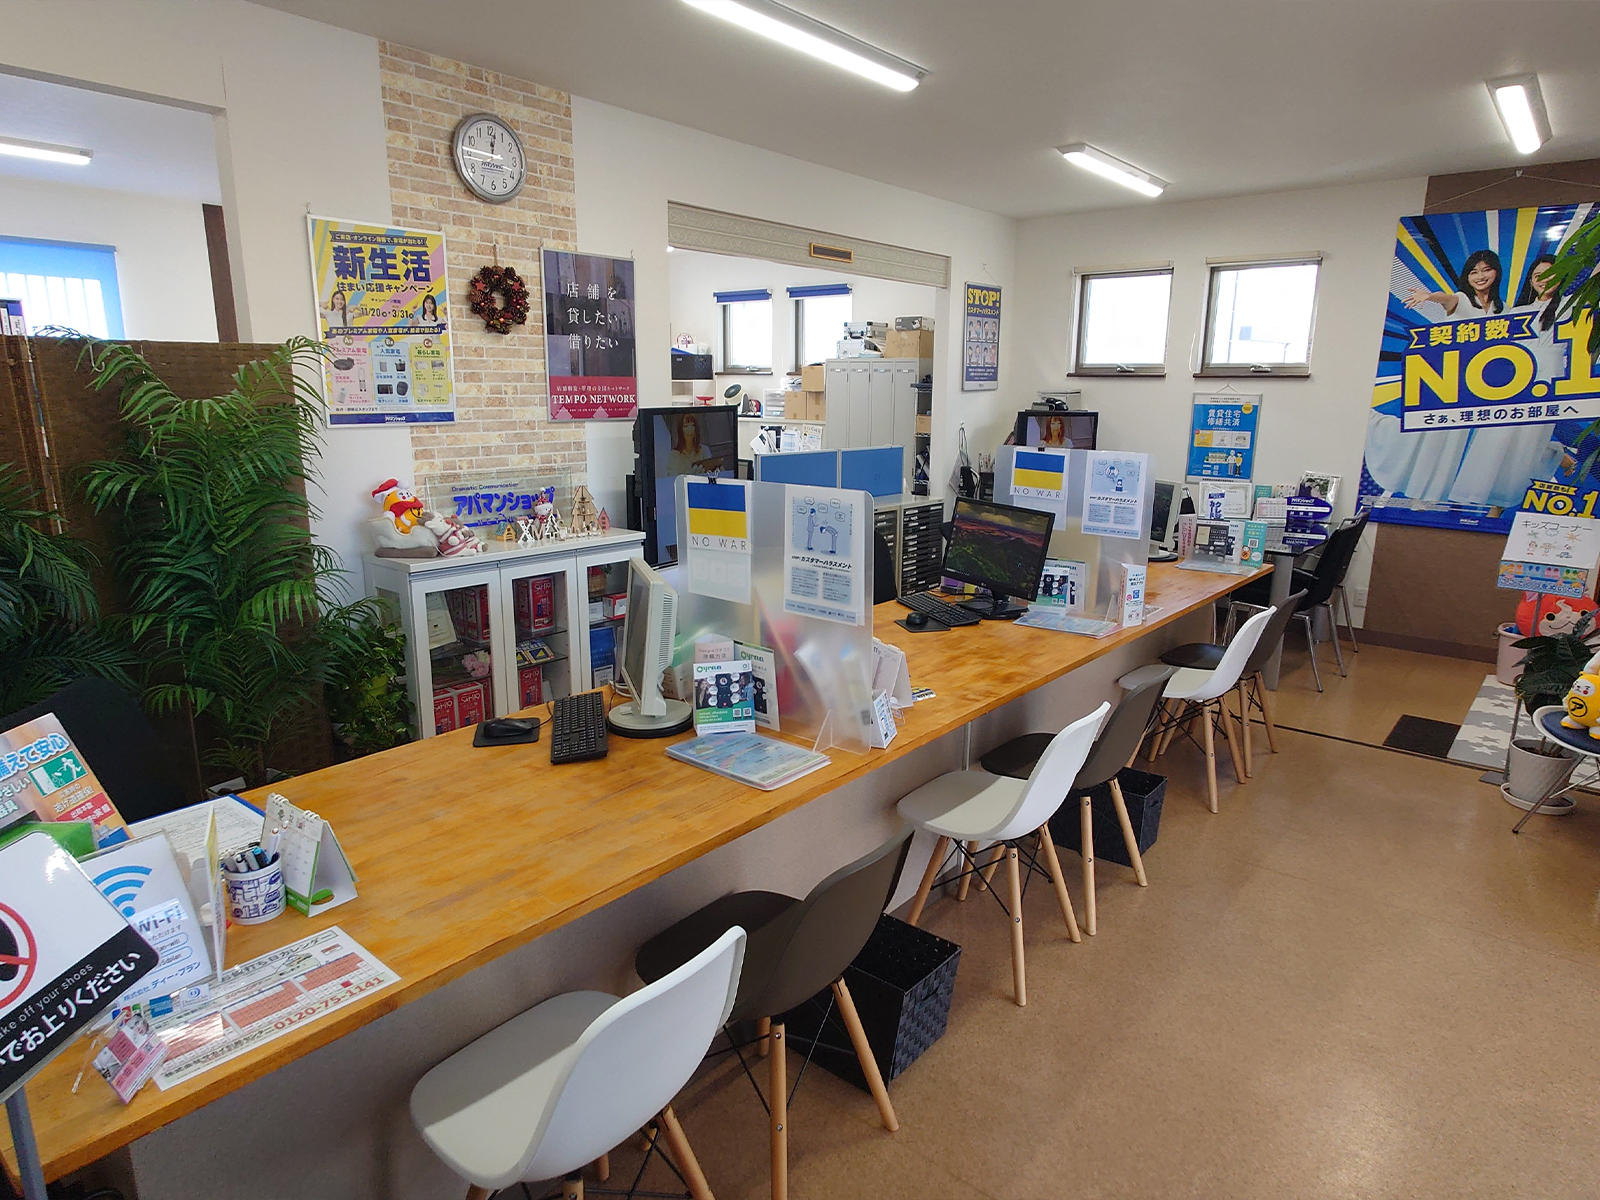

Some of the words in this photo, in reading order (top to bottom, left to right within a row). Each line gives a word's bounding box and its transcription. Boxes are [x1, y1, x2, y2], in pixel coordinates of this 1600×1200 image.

[476, 127, 482, 138] 11
[486, 125, 494, 137] 12
[468, 135, 476, 147] 10
[507, 142, 513, 153] 2
[470, 162, 476, 175] 8
[511, 156, 518, 168] 3
[480, 174, 486, 185] 7
[490, 180, 497, 191] 6
[502, 178, 508, 189] 5
[332, 246, 431, 282] 新生活
[337, 281, 434, 294] 住まい応援キャンペーン
[566, 282, 617, 300] 店舗を
[967, 288, 1000, 307] STOP!
[566, 307, 618, 325] 貸したい
[1429, 319, 1510, 347] 契約数
[568, 333, 619, 350] 借りたい
[1404, 306, 1600, 407] NO.1
[551, 394, 587, 404] TEMPO
[589, 394, 636, 404] NETWORK
[1208, 409, 1241, 418] 賃貸住宅
[1423, 404, 1579, 425] さぁ、理想のお部屋へ
[479, 482, 519, 490] Communication
[1014, 487, 1030, 496] NO
[1037, 488, 1061, 499] WAR
[1522, 490, 1599, 519] NO.1
[1521, 520, 1593, 532] キッズコーナー
[692, 536, 710, 547] NO
[718, 538, 747, 551] WAR
[800, 556, 853, 569] カスタマーハラスメント
[0, 777, 31, 800] さしい
[138, 904, 182, 933] Wi-Fi
[148, 924, 182, 942] ただけます
[19, 1004, 36, 1022] off
[36, 988, 61, 1011] your
[61, 963, 94, 991] shoes
[123, 986, 151, 1002] 株式会社
[273, 976, 386, 1031] 0120-75-1141
